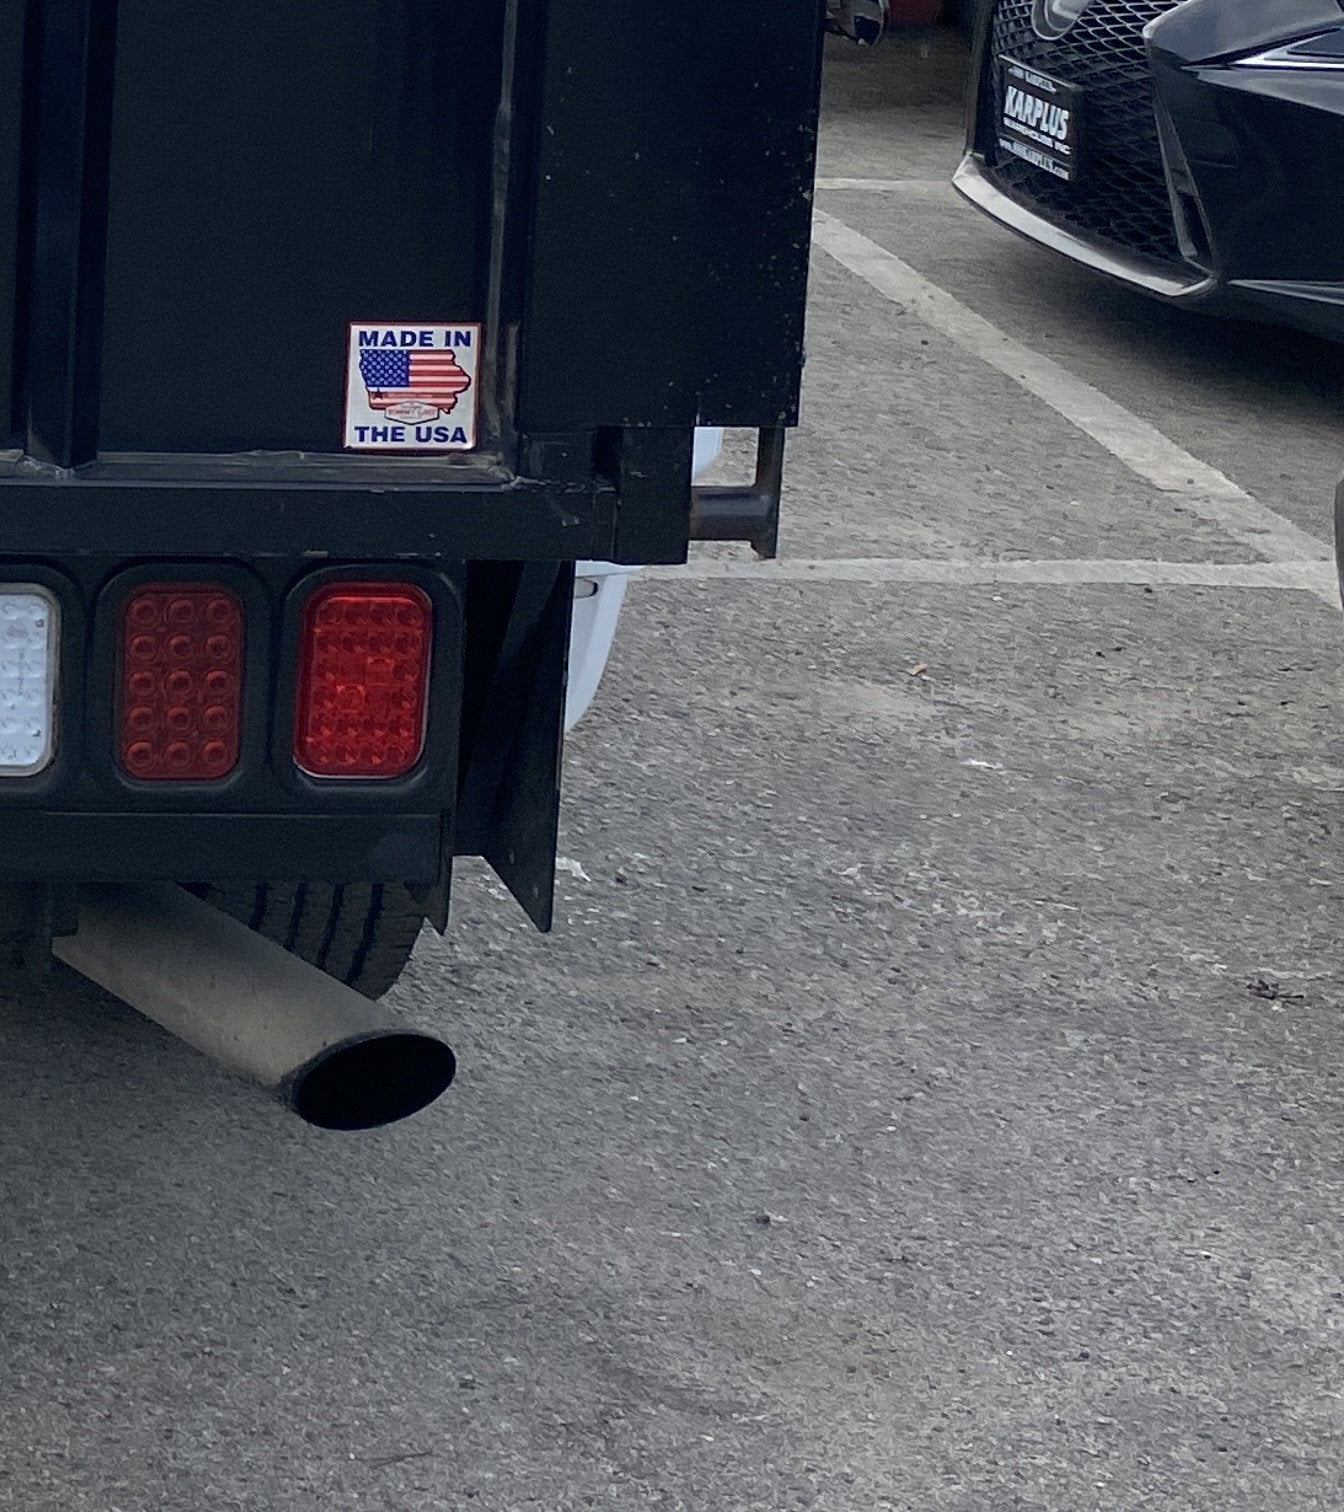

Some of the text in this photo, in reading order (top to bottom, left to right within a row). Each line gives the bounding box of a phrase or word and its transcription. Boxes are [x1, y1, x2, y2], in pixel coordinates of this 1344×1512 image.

[1004, 85, 1070, 140] KARPLUS
[358, 331, 471, 347] MADE IN
[354, 426, 467, 443] THE USA
